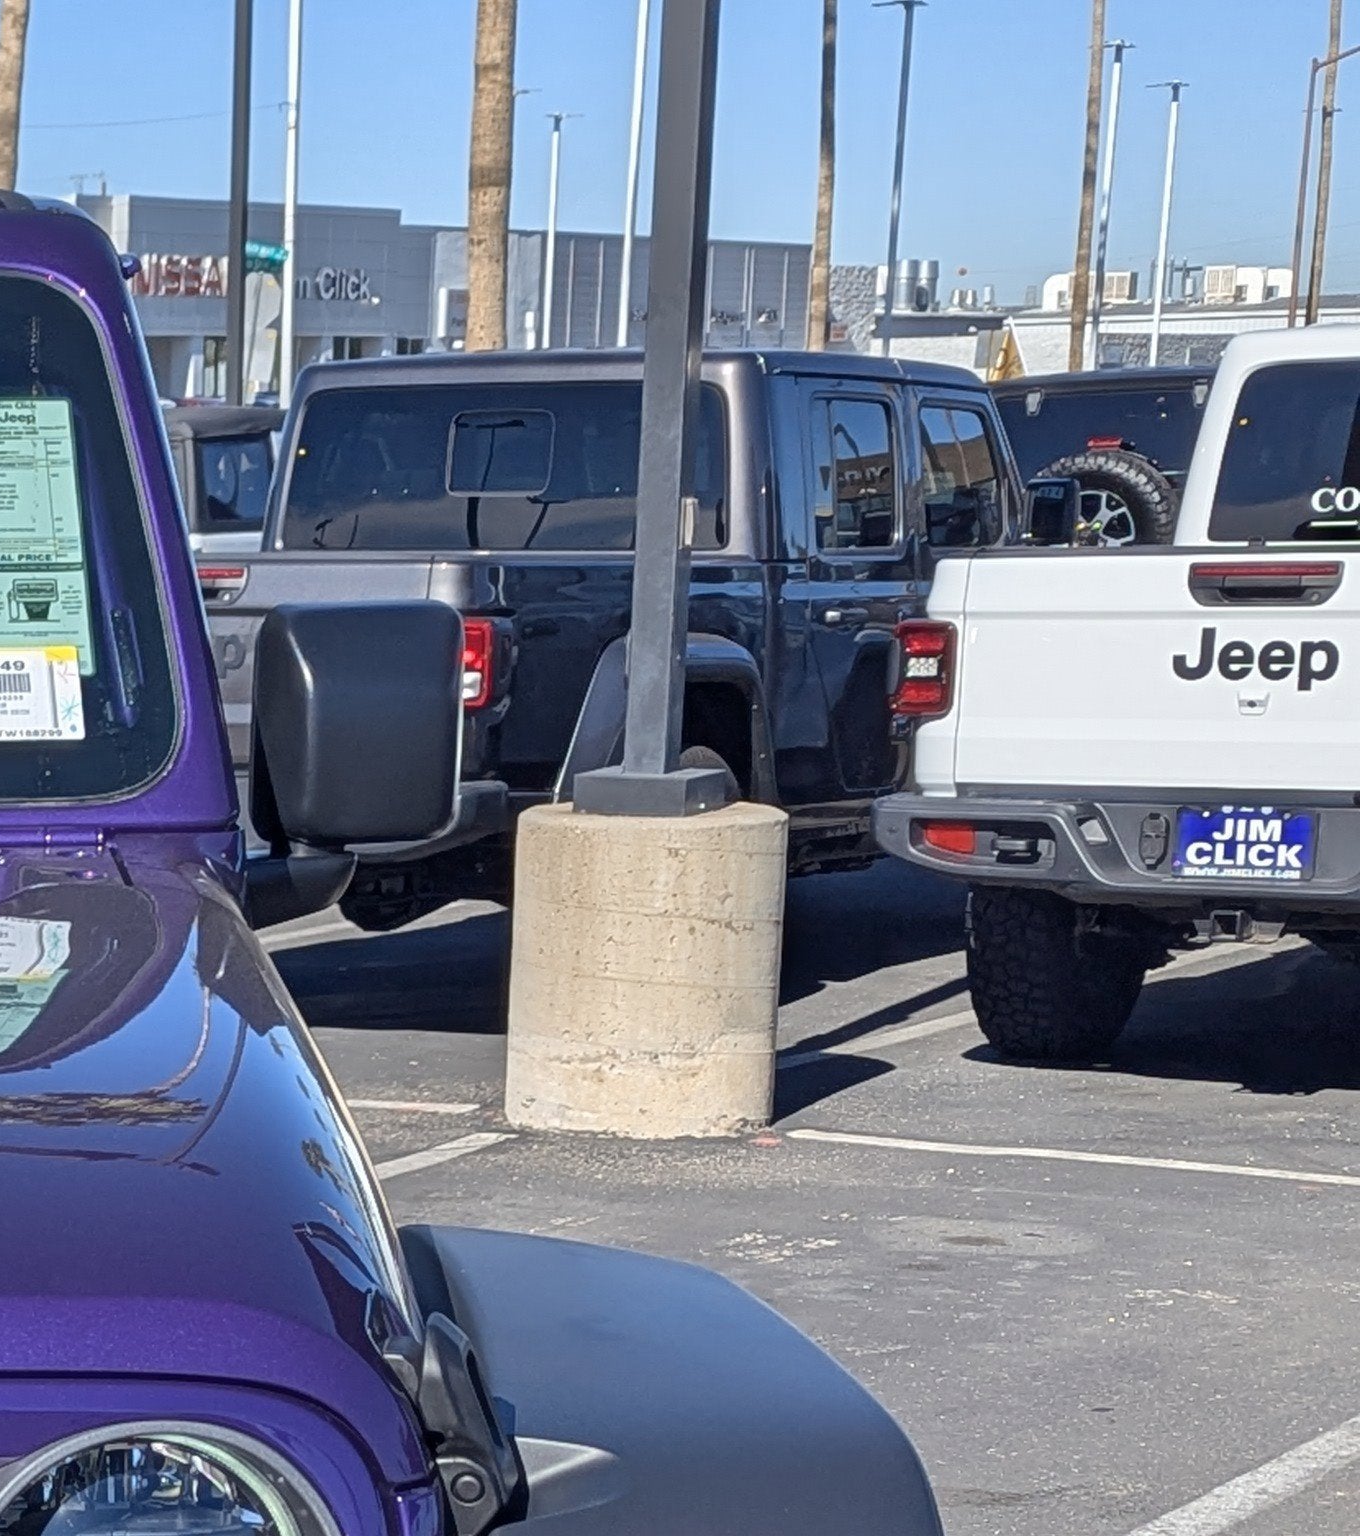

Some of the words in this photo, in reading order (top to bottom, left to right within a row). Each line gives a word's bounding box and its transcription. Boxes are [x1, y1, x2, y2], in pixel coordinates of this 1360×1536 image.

[133, 252, 229, 298] NISSA
[317, 266, 372, 300] Click
[17, 553, 53, 562] PRICE
[1172, 626, 1340, 692] Jeep
[1211, 817, 1283, 842] JIM
[1185, 841, 1304, 868] CLICK
